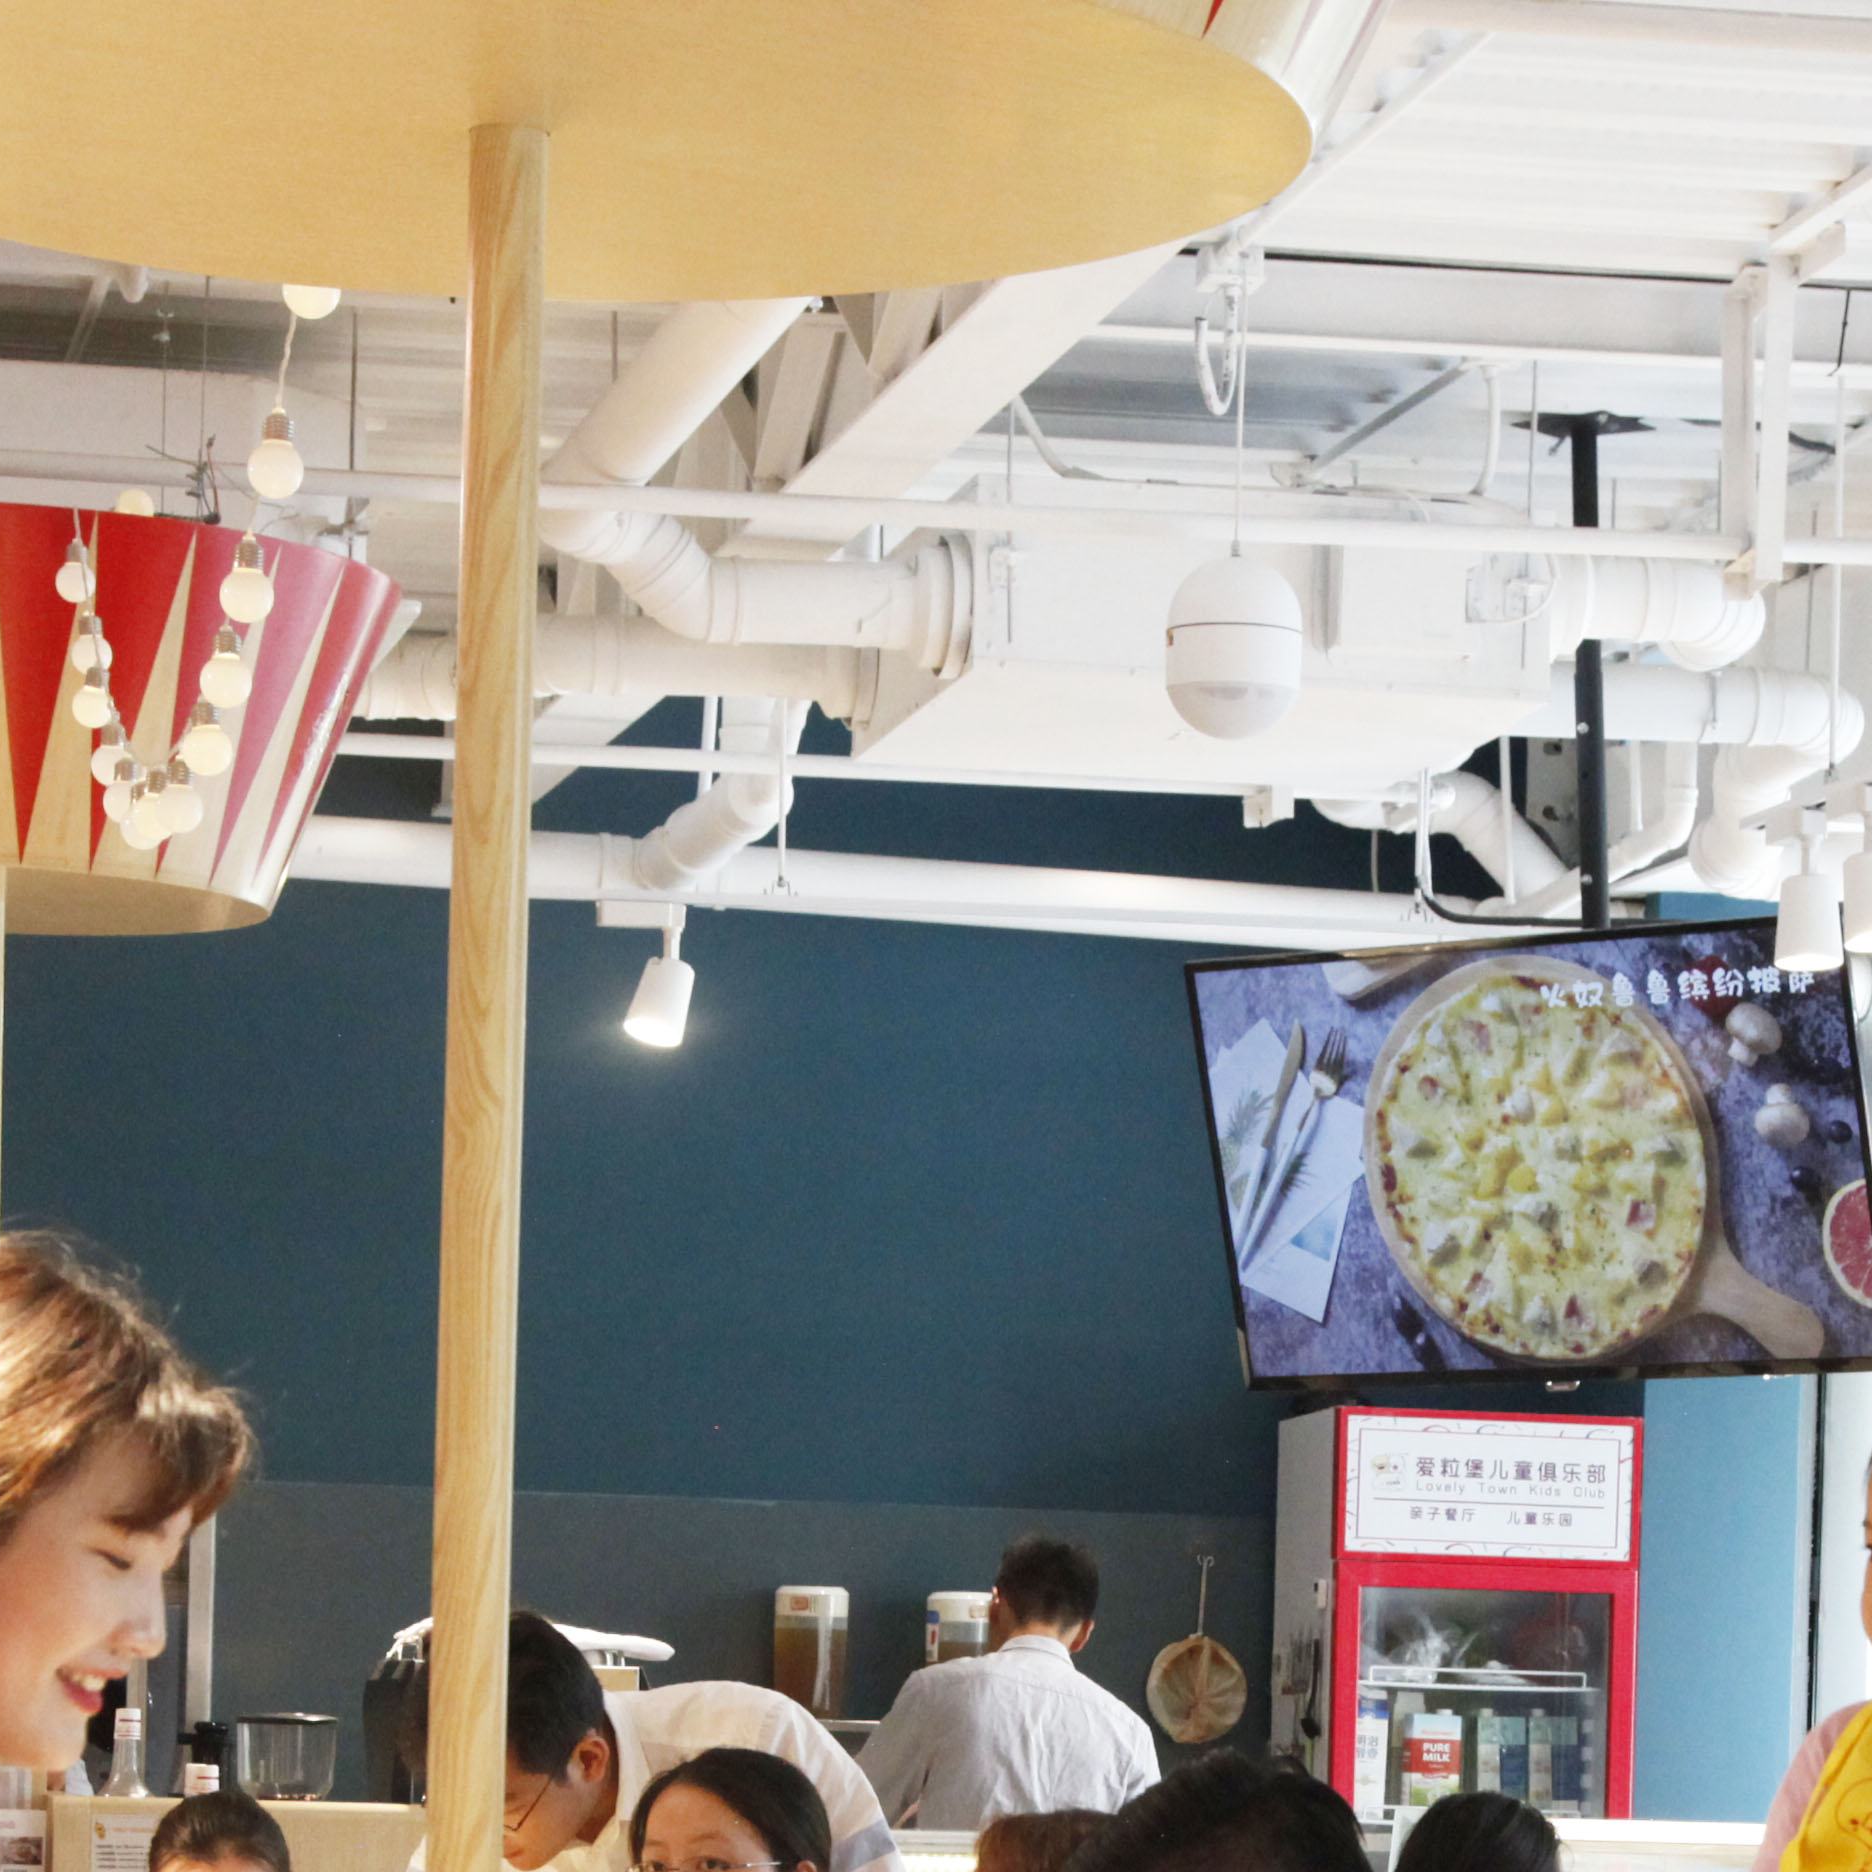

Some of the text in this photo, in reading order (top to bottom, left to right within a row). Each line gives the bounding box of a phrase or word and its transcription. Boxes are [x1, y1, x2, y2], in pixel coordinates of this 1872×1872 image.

[1416, 1457, 1606, 1484] 爱粒堡儿童俱乐部
[1416, 1480, 1605, 1499] Lovely Town Kids Club
[1409, 1506, 1572, 1527] 亲子餐厅 儿童乐园
[1422, 1742, 1451, 1753] PURE
[1422, 1753, 1451, 1762] MILK
